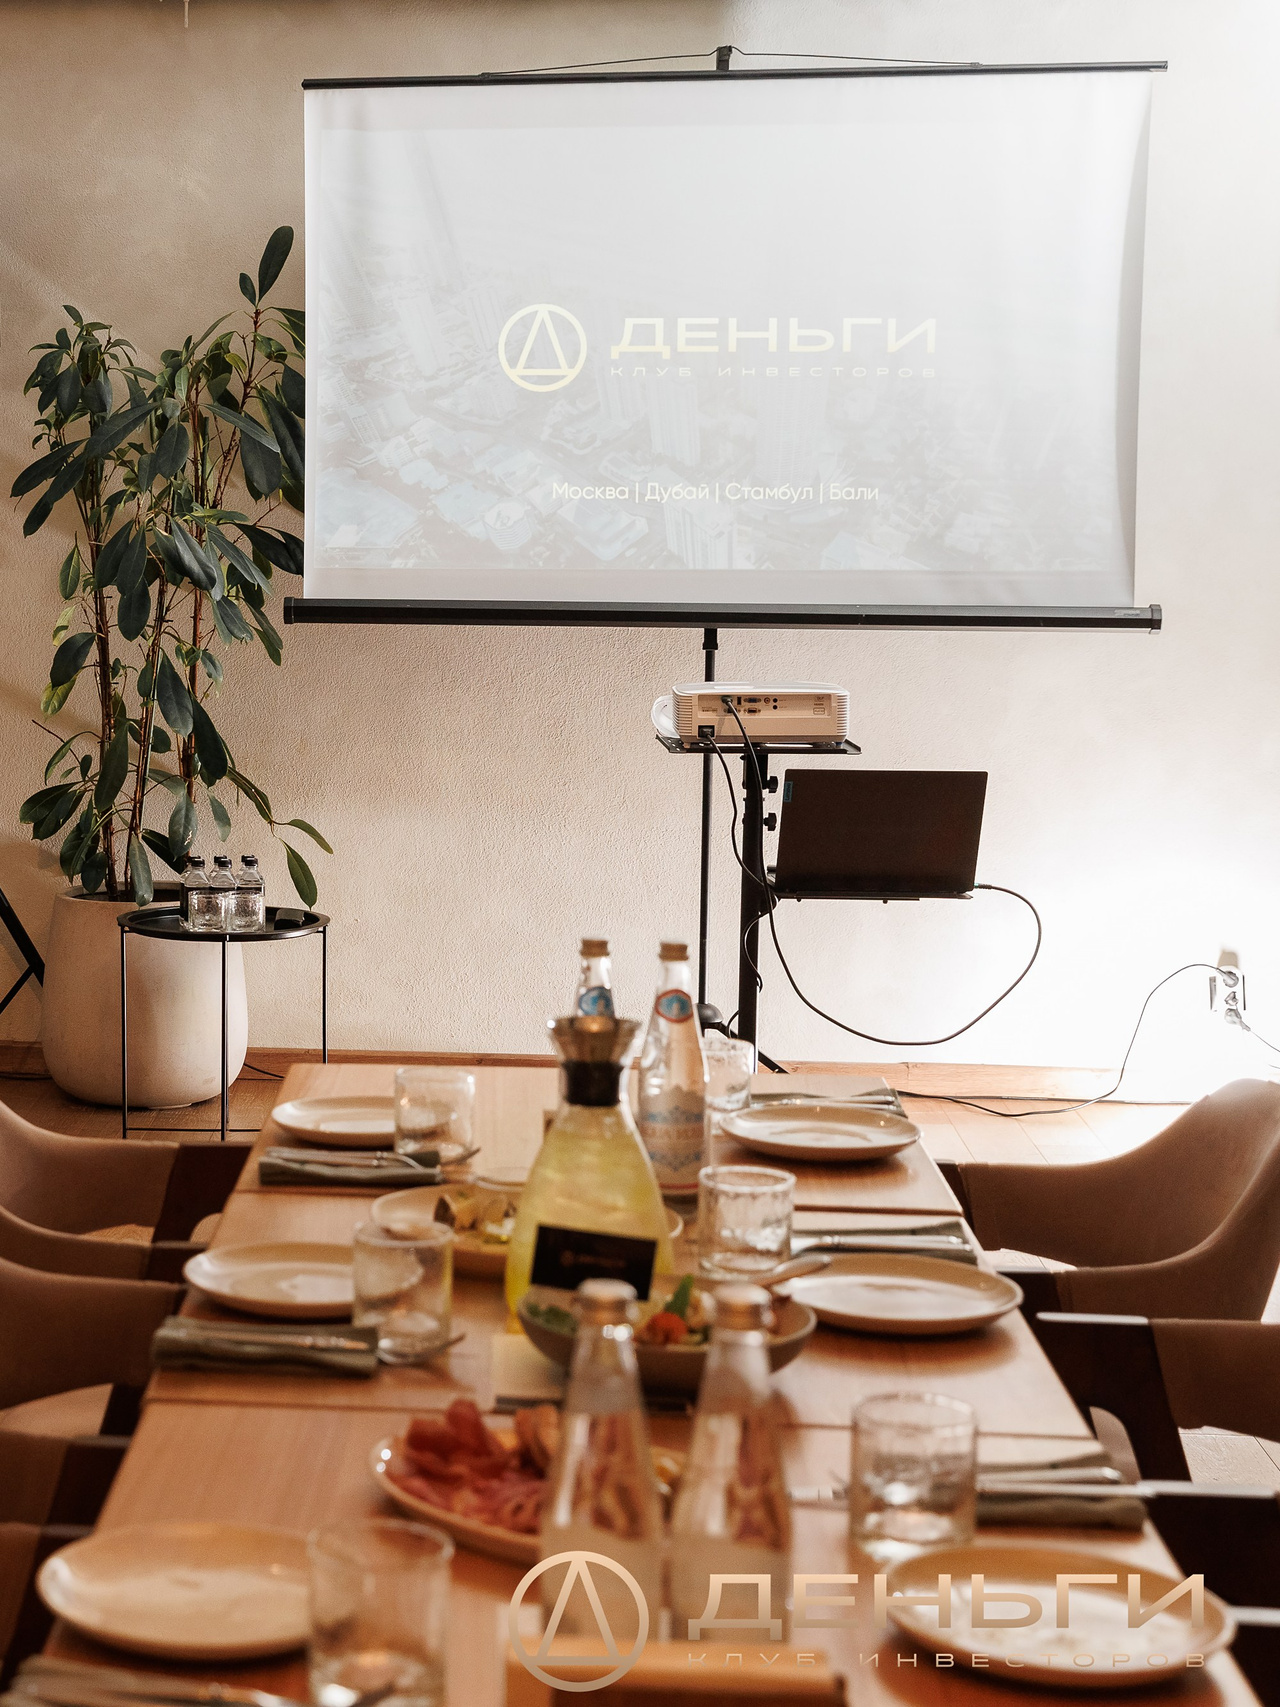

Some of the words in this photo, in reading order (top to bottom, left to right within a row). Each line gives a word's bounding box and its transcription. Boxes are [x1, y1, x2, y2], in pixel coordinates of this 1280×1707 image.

[610, 317, 936, 359] ДЕНЬГИ
[610, 367, 692, 377] КЛУБ
[718, 367, 936, 378] ИНВЕСТОРОВ
[552, 482, 629, 500] Москва
[645, 482, 709, 504] Дубай
[725, 482, 813, 504] Стамбул
[829, 483, 879, 500] Бали
